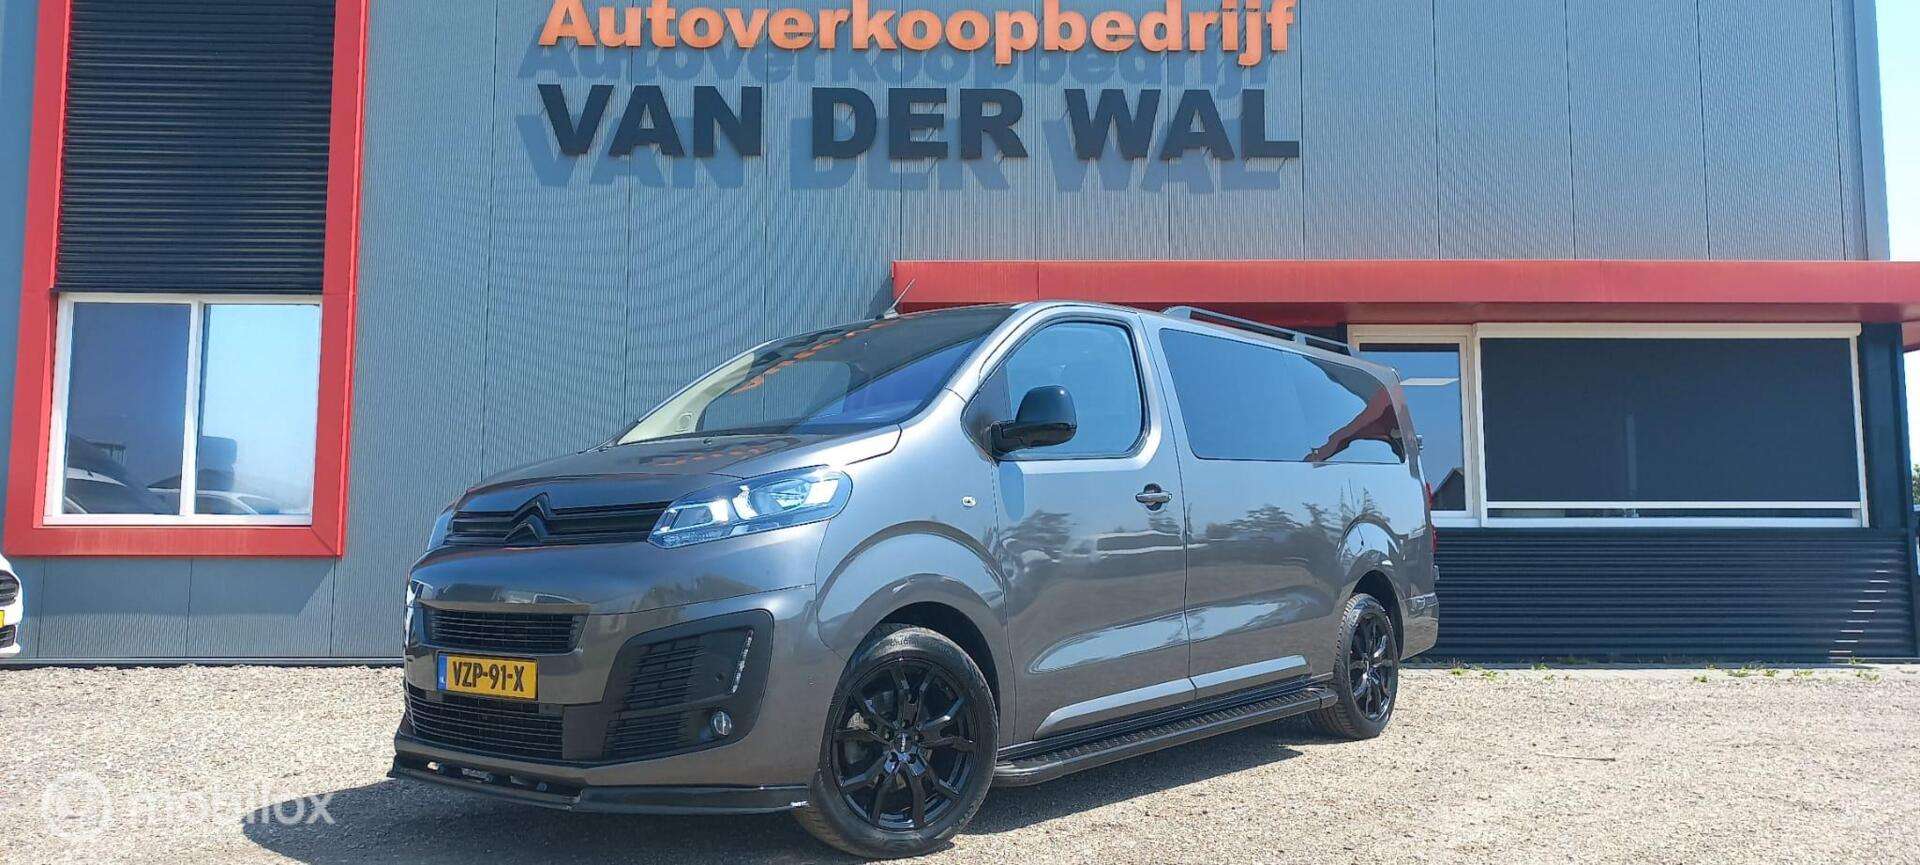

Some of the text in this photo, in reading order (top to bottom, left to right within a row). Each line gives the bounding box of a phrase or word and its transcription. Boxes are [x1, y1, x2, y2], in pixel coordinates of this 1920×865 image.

[538, 0, 1296, 67] Autoverkoopbedrijf
[537, 84, 1299, 160] VAN DER WAL
[452, 661, 524, 692] VZP-91-X
